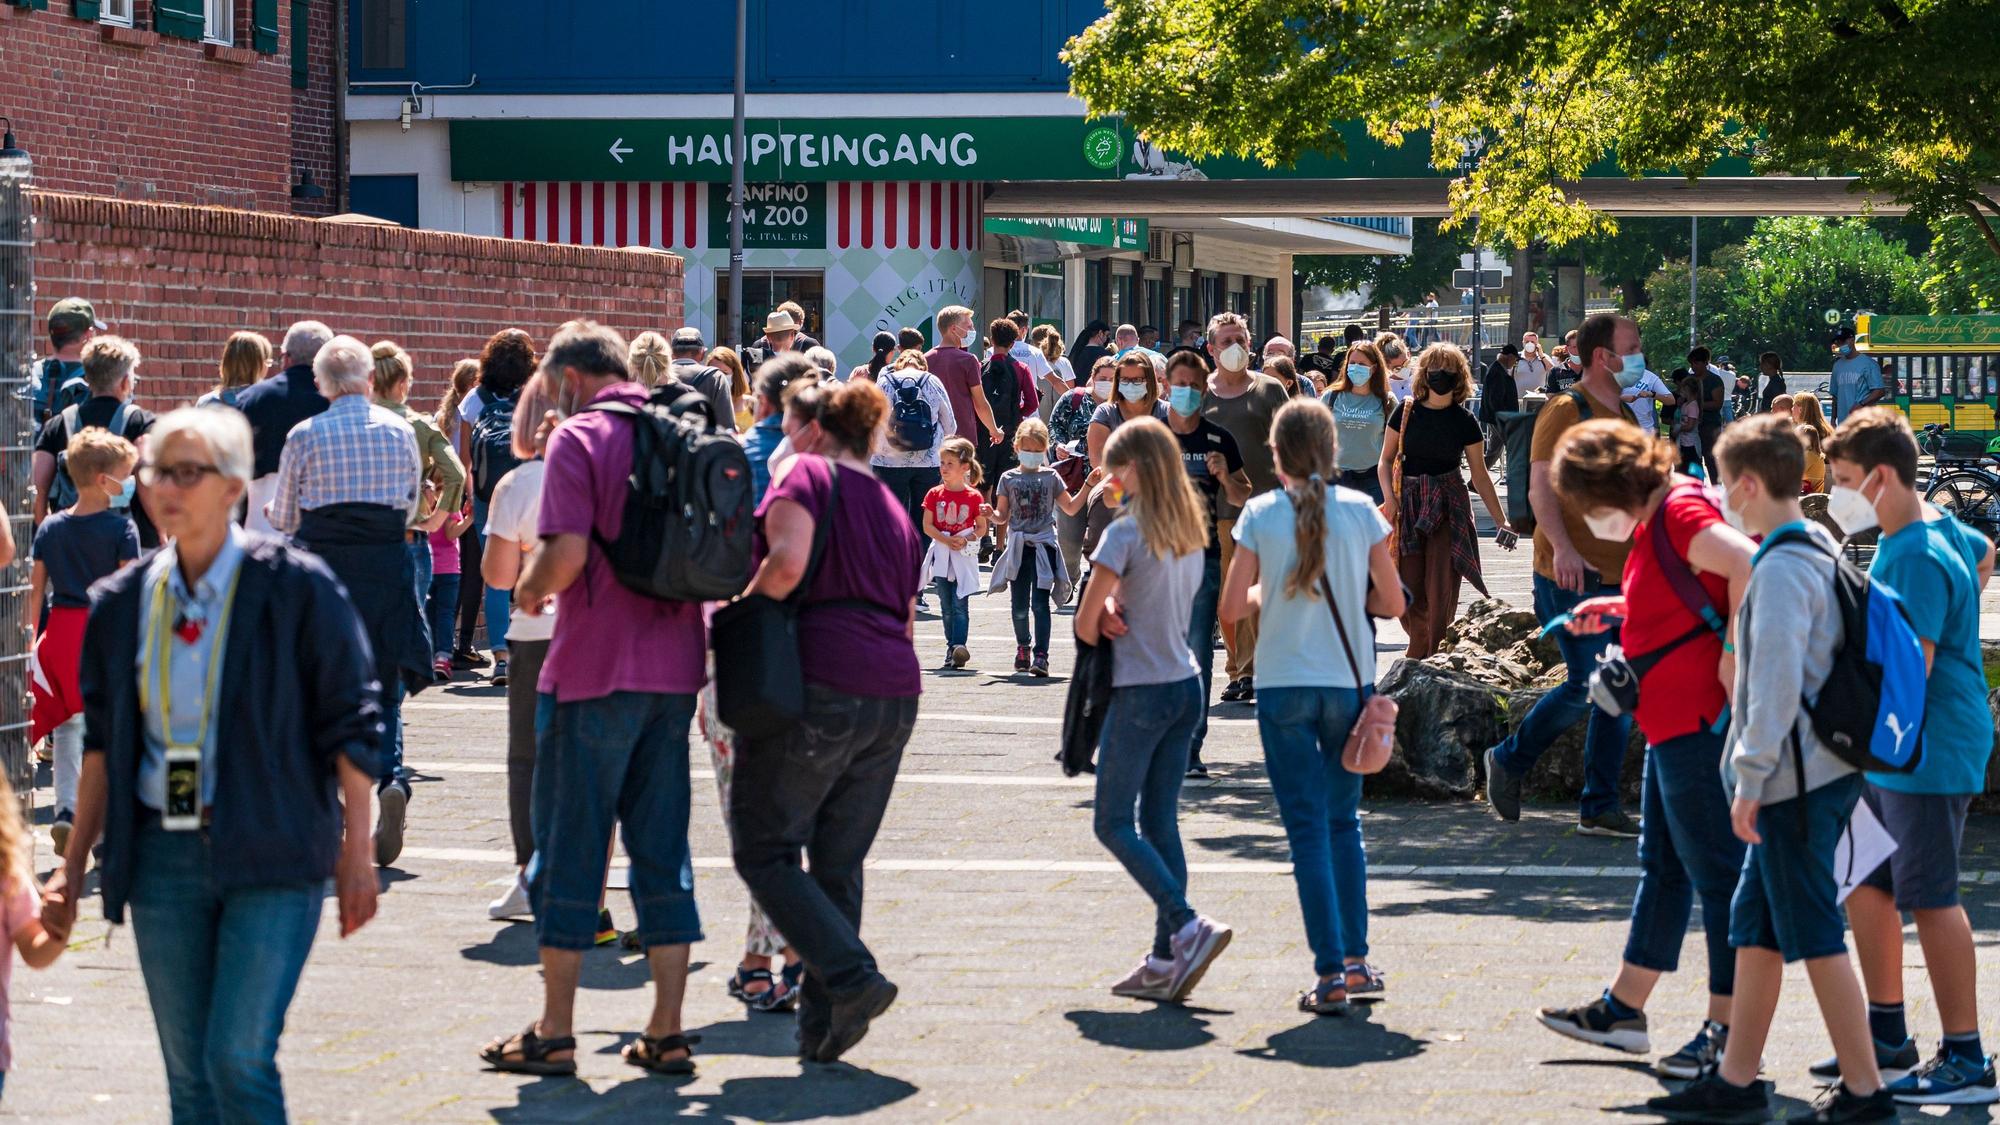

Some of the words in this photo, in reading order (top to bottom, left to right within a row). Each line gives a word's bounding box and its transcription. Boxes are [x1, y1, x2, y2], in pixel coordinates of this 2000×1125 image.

[668, 132, 977, 168] HAUPTEINGANG
[763, 205, 808, 226] ZOO
[791, 233, 808, 241] EIS
[1828, 312, 1838, 322] H
